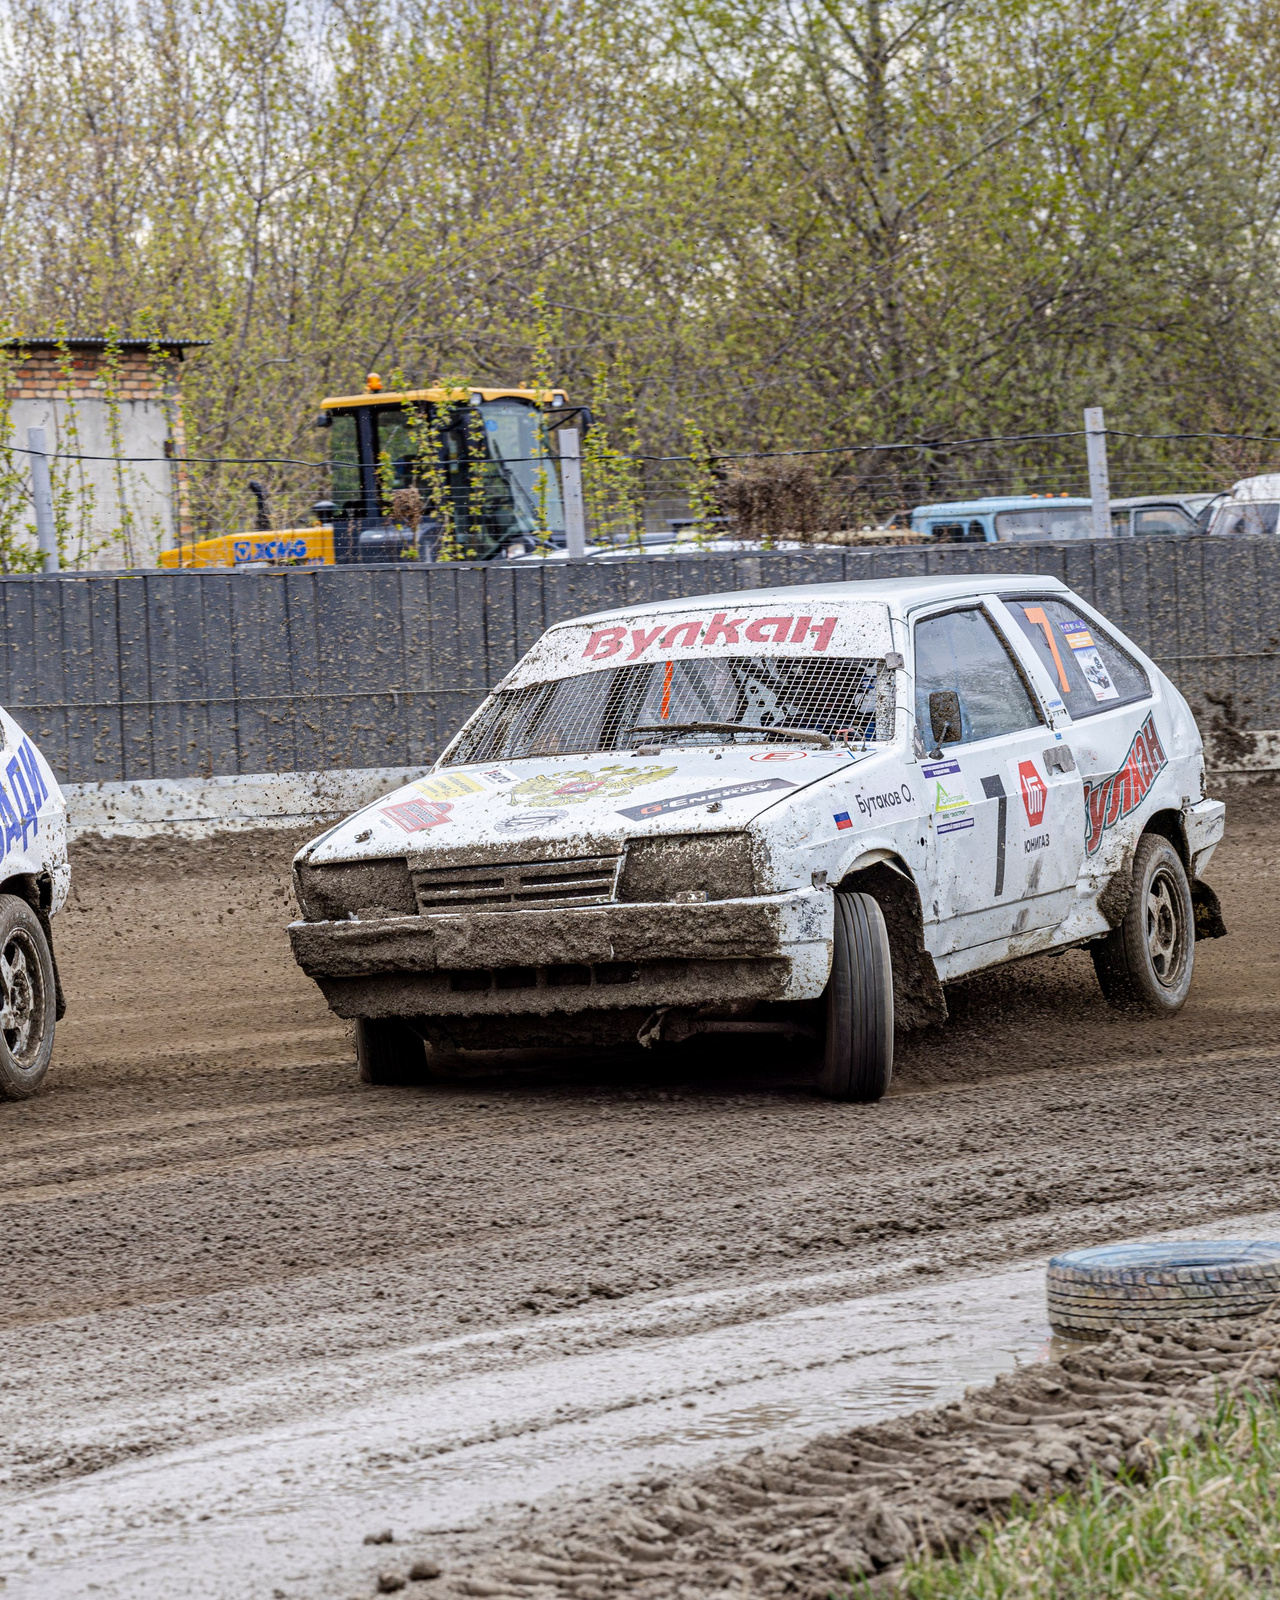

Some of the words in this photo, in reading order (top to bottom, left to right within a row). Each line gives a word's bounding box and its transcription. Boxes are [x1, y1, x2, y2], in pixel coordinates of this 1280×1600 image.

[1024, 607, 1071, 693] 7
[855, 791, 902, 817] Бутаков
[901, 783, 915, 803] О.
[980, 774, 1008, 897] 7
[1024, 833, 1051, 855] ЮНИГАЗ
